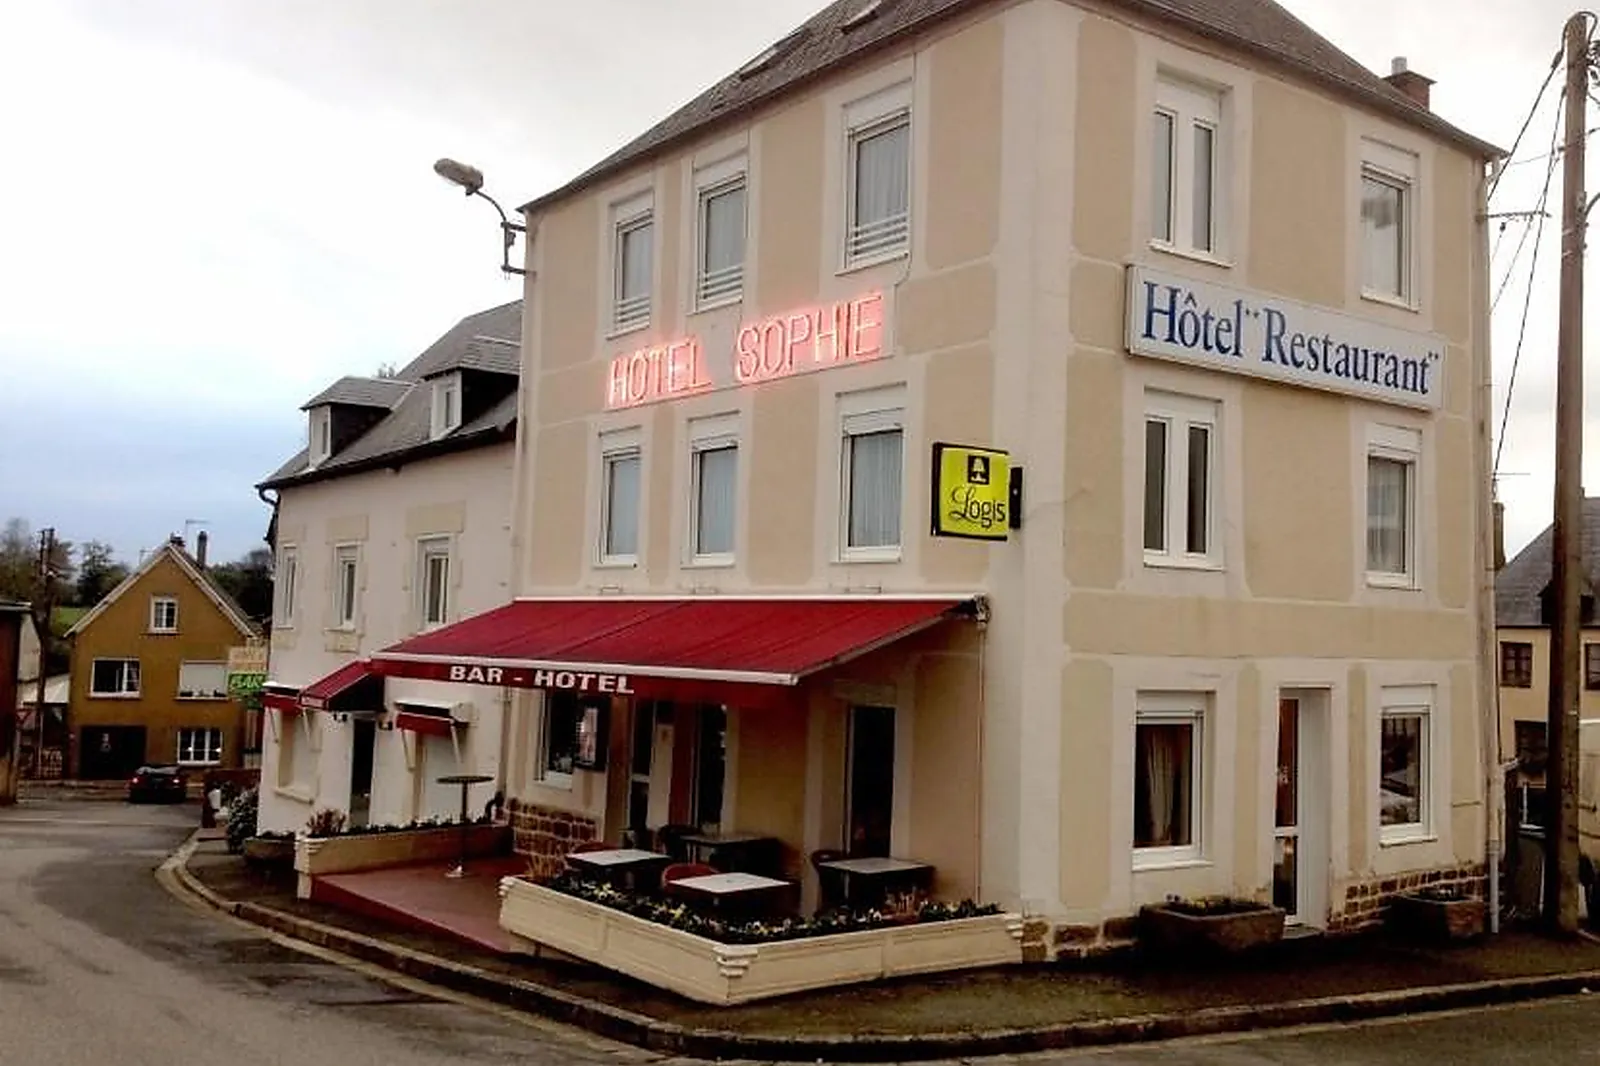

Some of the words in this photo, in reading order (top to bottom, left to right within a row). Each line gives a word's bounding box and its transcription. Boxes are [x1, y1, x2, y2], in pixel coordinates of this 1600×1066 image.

[606, 336, 712, 406] HOTEL
[735, 293, 882, 385] SOPHIE
[1142, 280, 1243, 358] Hôtel
[1261, 307, 1430, 395] Restaurant
[948, 486, 1006, 529] Logis
[450, 665, 504, 684] BAR
[534, 669, 635, 695] HOTEL
